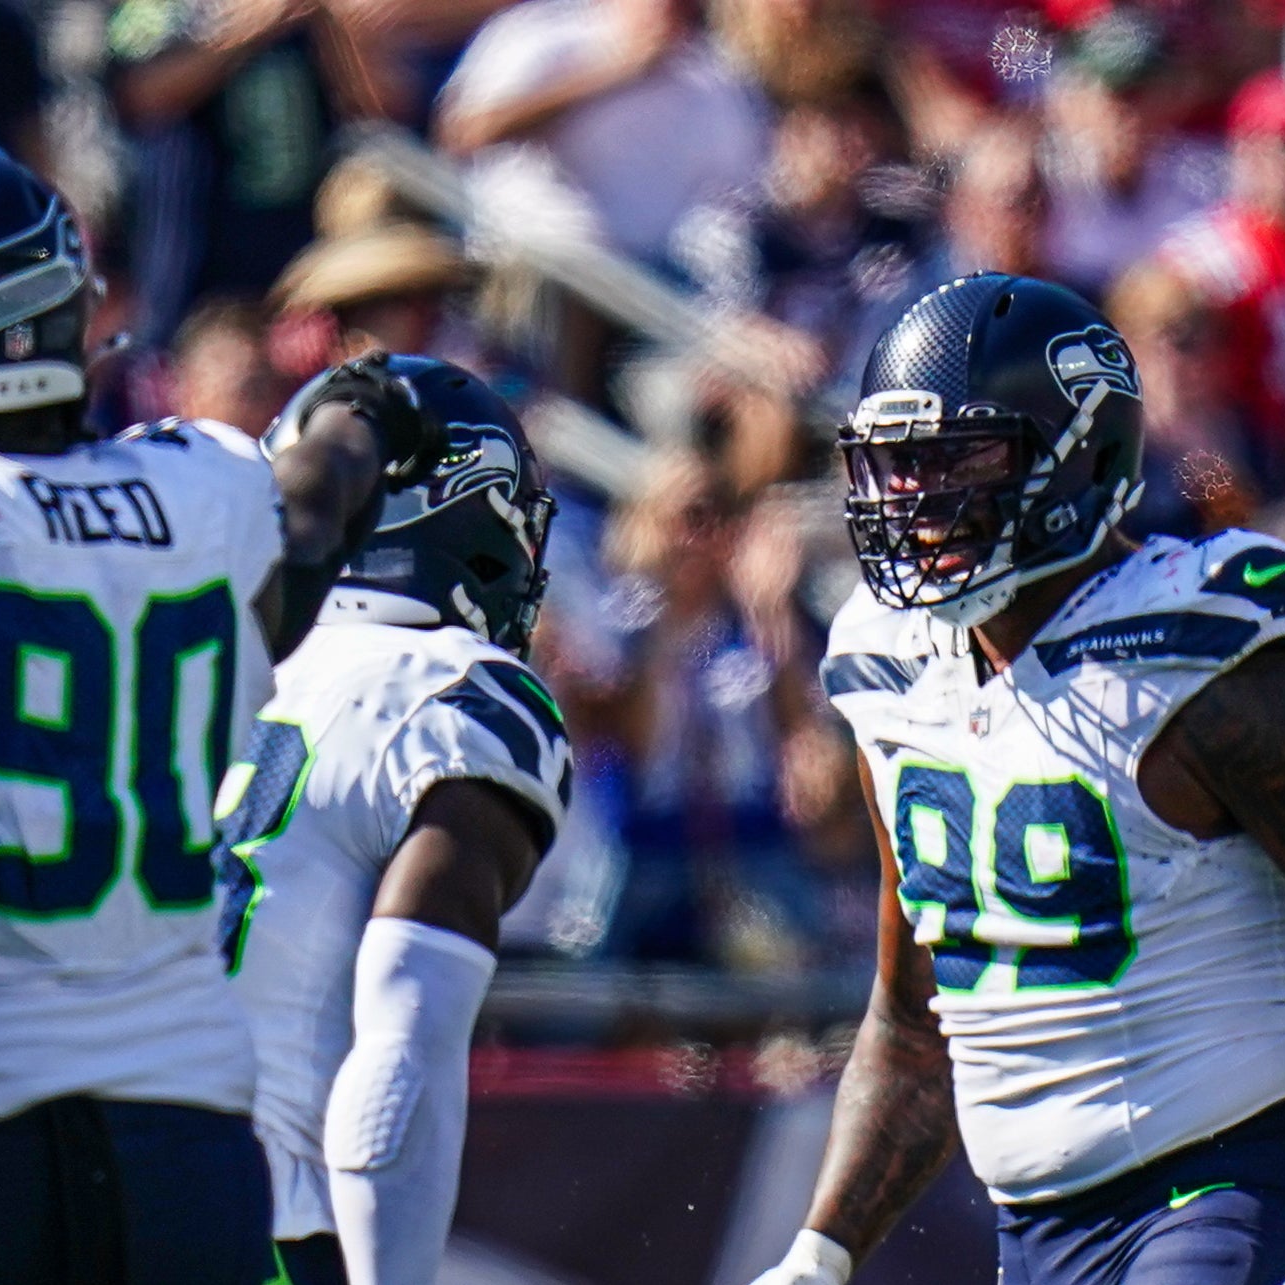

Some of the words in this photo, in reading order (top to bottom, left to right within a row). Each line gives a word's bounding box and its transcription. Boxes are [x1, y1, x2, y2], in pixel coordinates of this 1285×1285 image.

[20, 473, 174, 550] REED
[1066, 627, 1165, 658] SEAHAWKS
[895, 758, 1139, 996] 99
